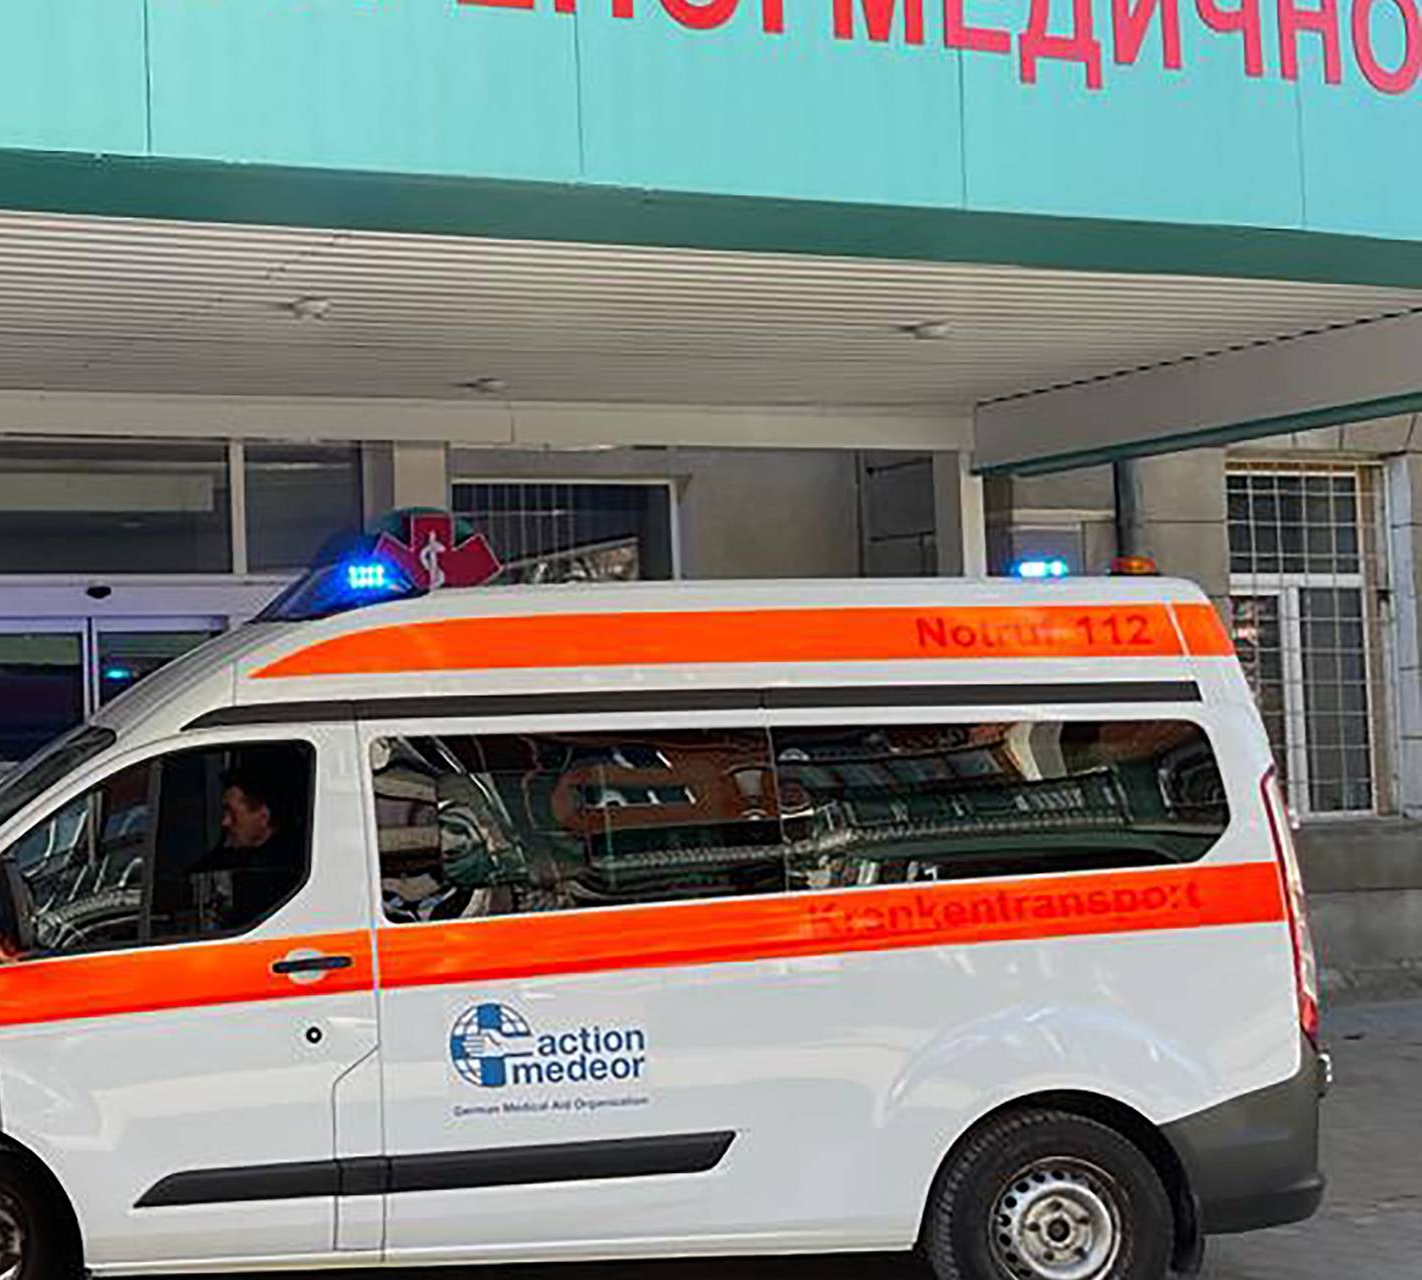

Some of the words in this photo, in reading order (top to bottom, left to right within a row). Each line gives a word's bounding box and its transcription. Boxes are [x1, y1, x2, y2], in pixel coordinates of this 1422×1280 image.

[1074, 613, 1155, 646] 112
[537, 1026, 645, 1056] action
[512, 1055, 645, 1085] medeor
